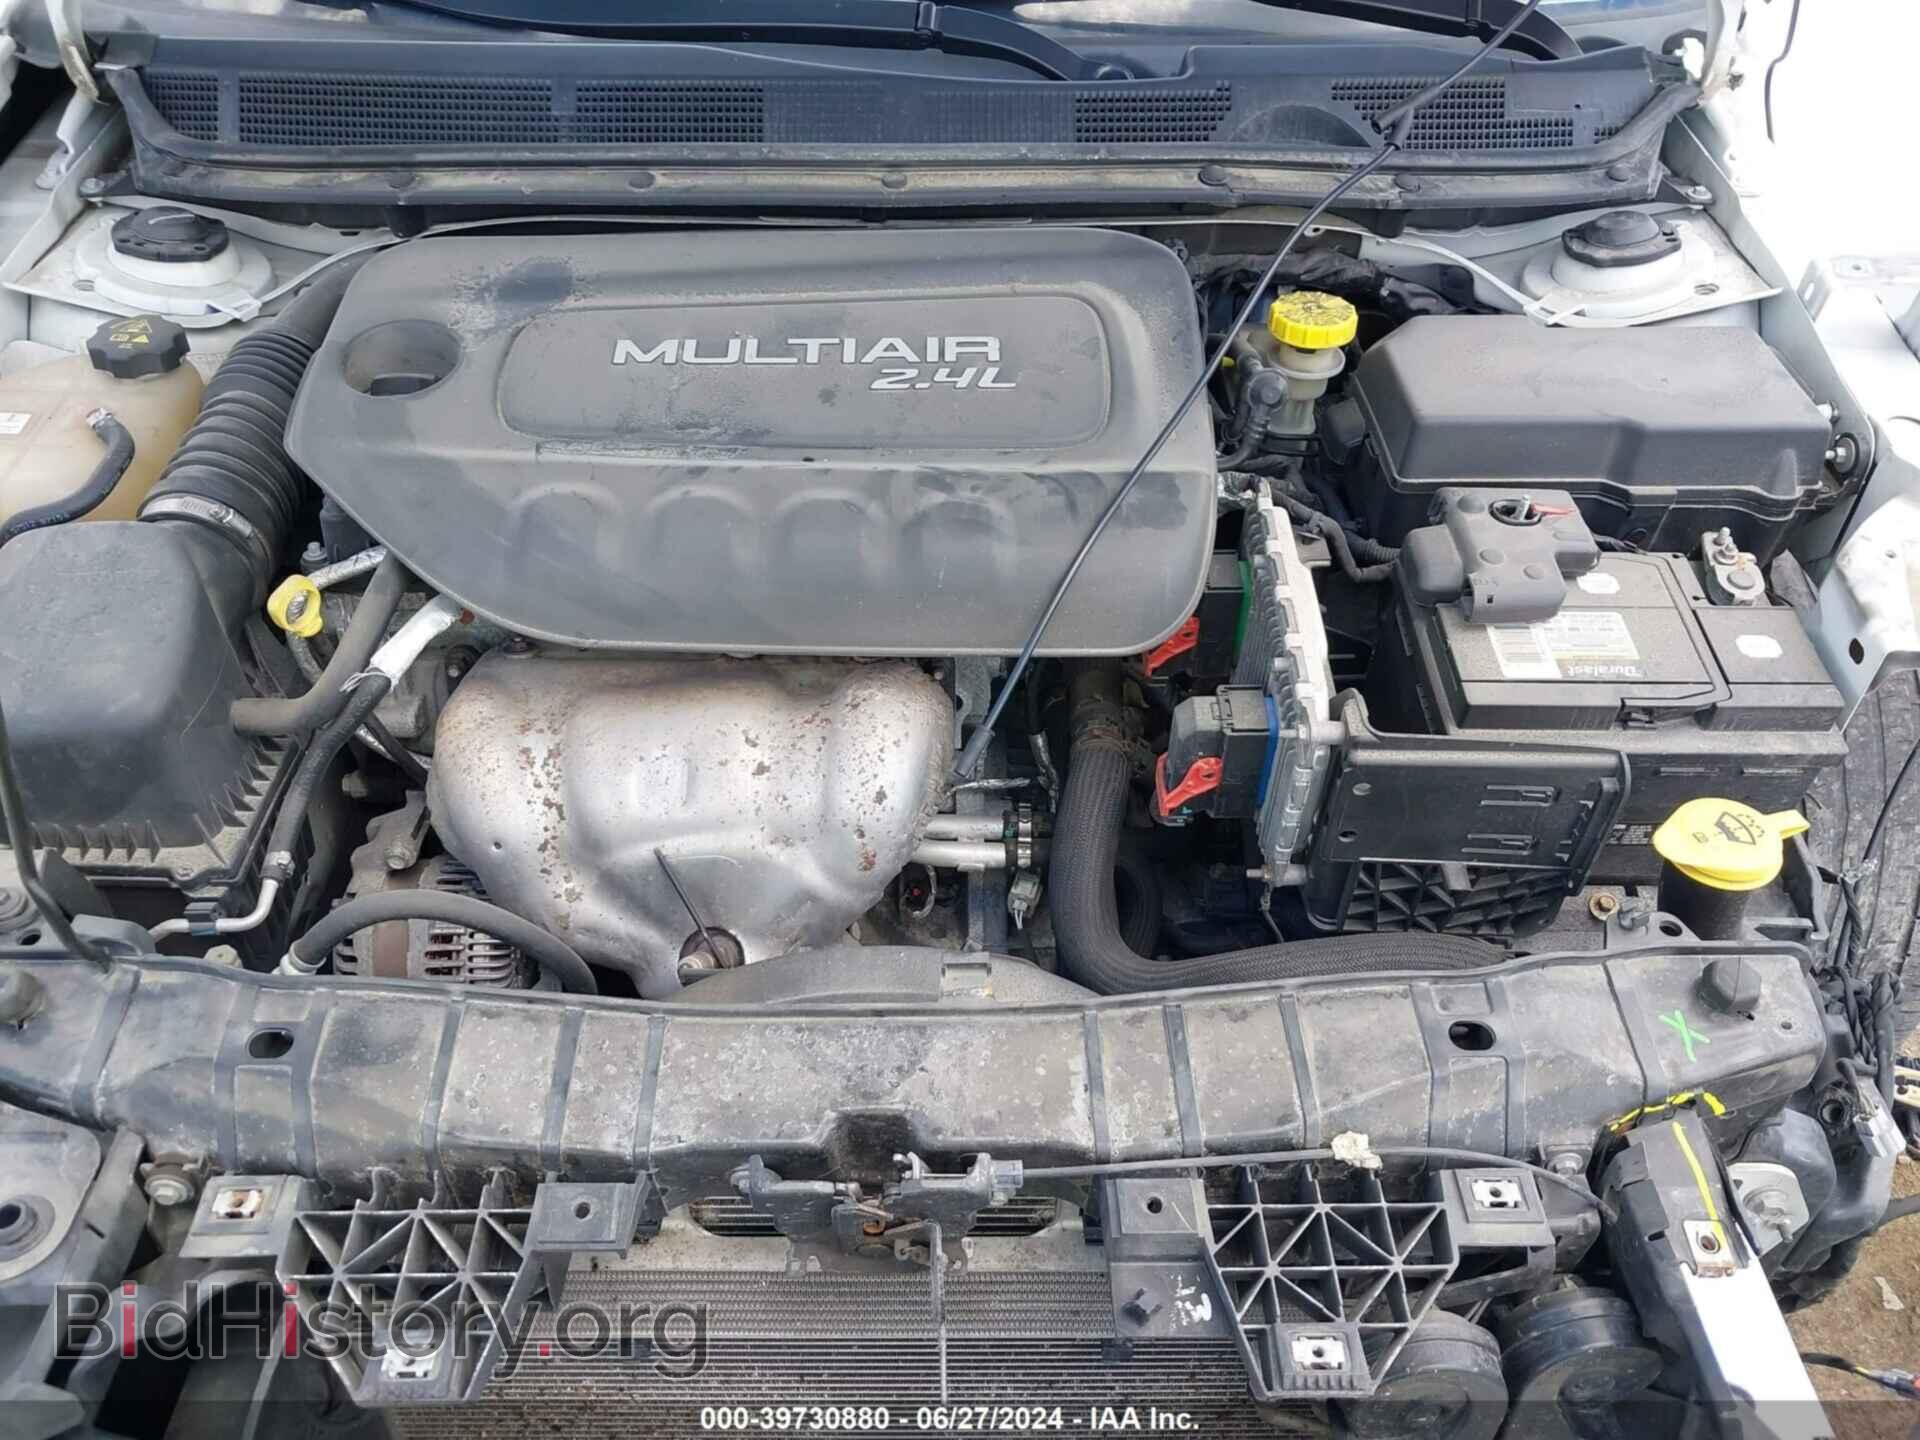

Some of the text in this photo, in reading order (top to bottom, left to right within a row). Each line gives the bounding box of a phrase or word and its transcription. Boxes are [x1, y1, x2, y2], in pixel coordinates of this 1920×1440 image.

[611, 336, 1001, 364] MULTIAIR
[868, 368, 1017, 390] 2.4L
[1566, 663, 1643, 678] Duralast
